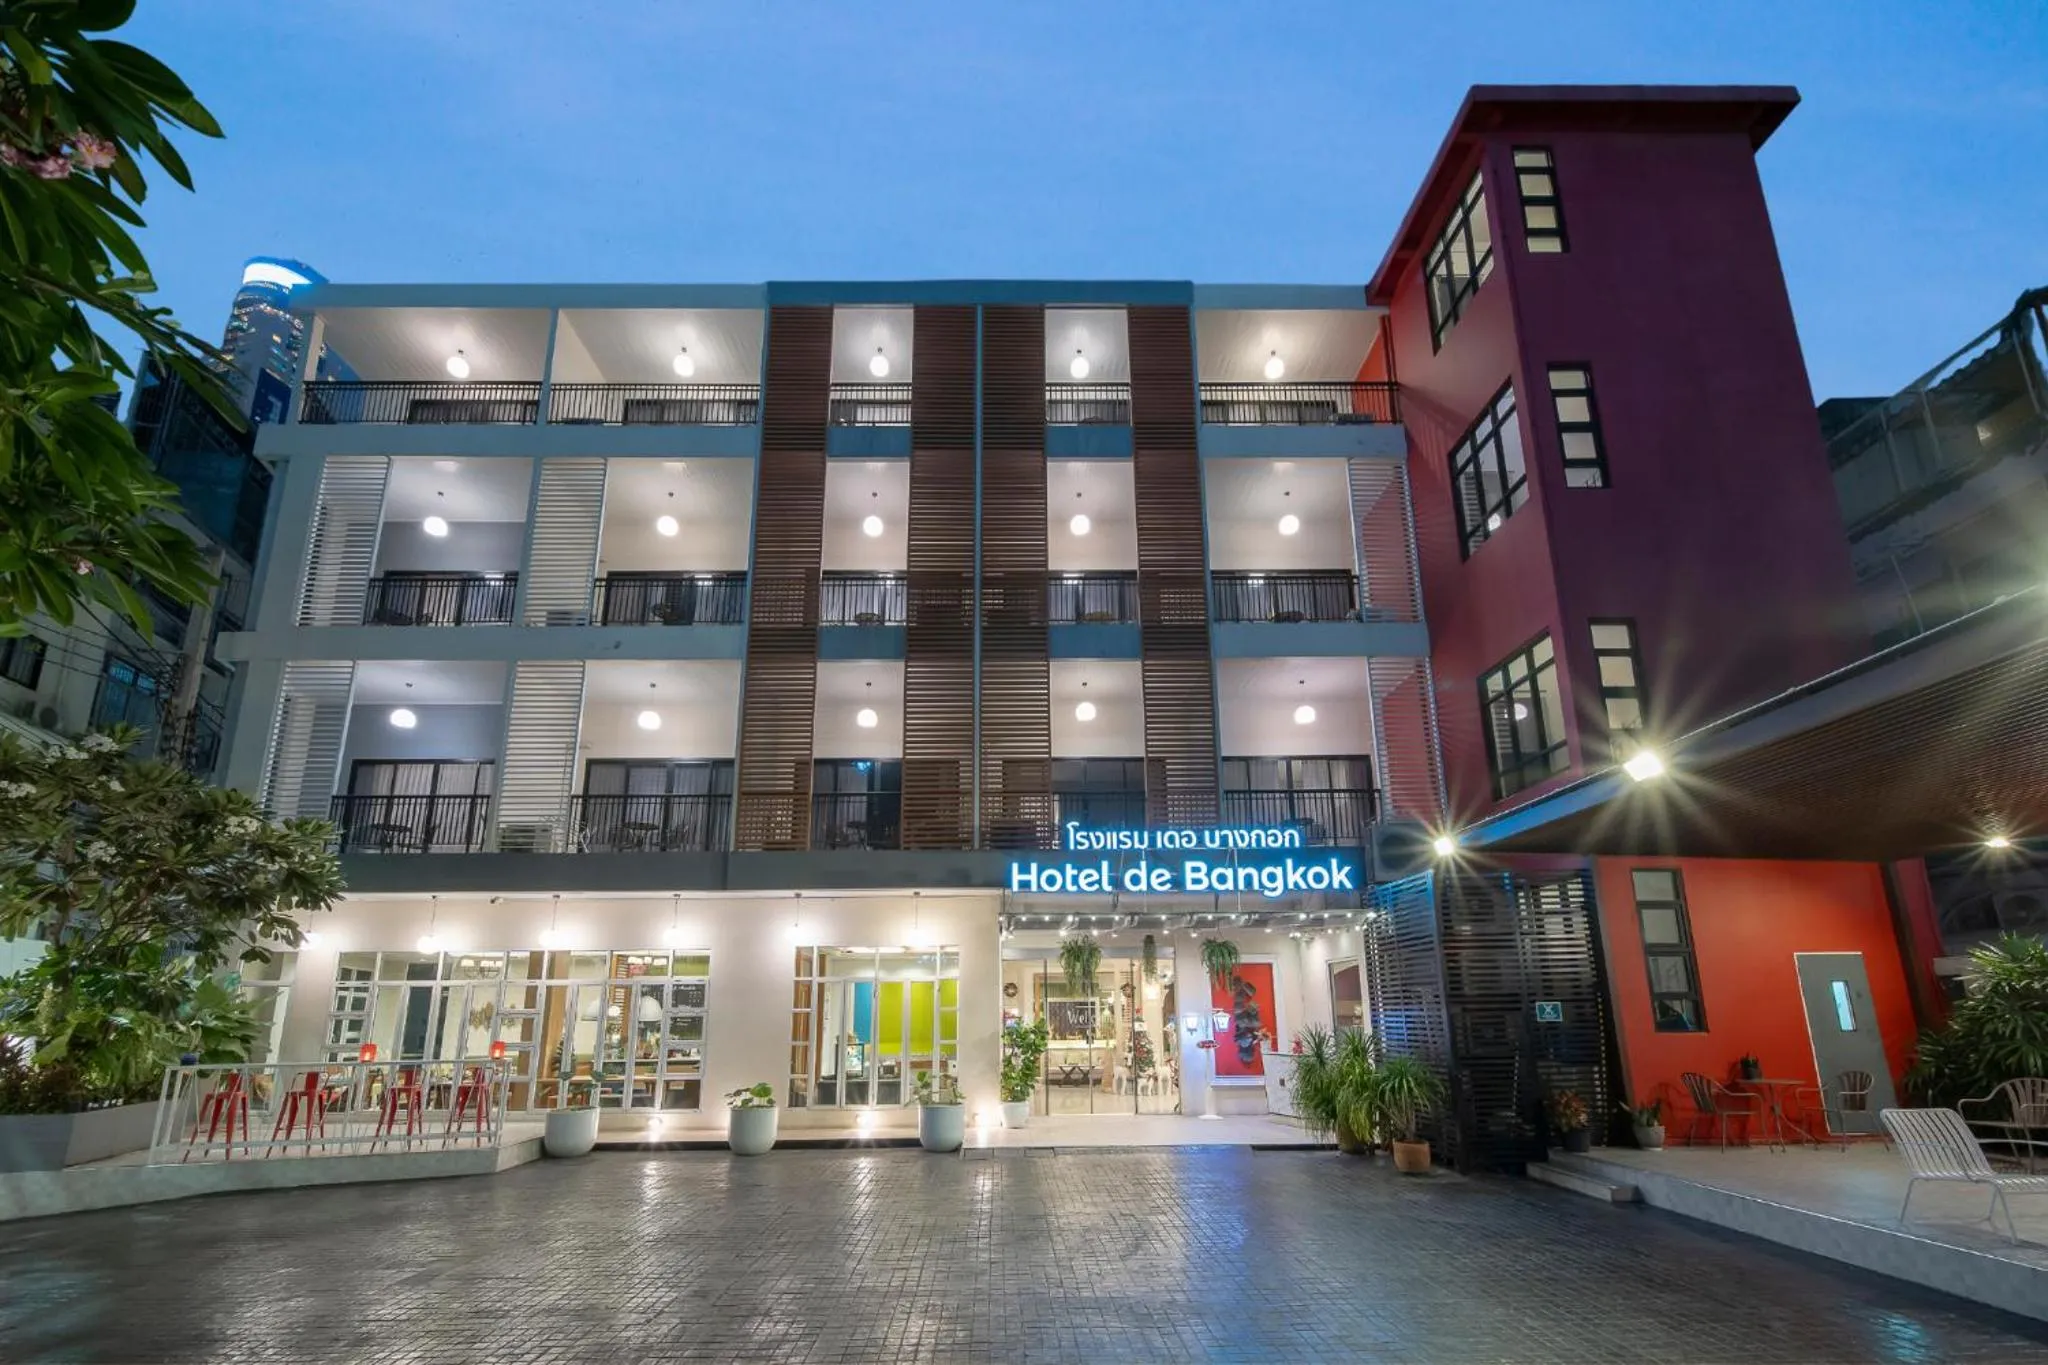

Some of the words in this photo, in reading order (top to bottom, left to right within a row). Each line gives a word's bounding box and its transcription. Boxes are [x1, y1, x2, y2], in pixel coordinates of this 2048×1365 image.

[1066, 821, 1149, 850] โรงแรม
[1156, 830, 1197, 849] เดอ
[1204, 828, 1300, 849] บางกอก
[1012, 860, 1113, 892] Hotel
[1124, 860, 1172, 892] de
[1184, 857, 1353, 897] Bangkok
